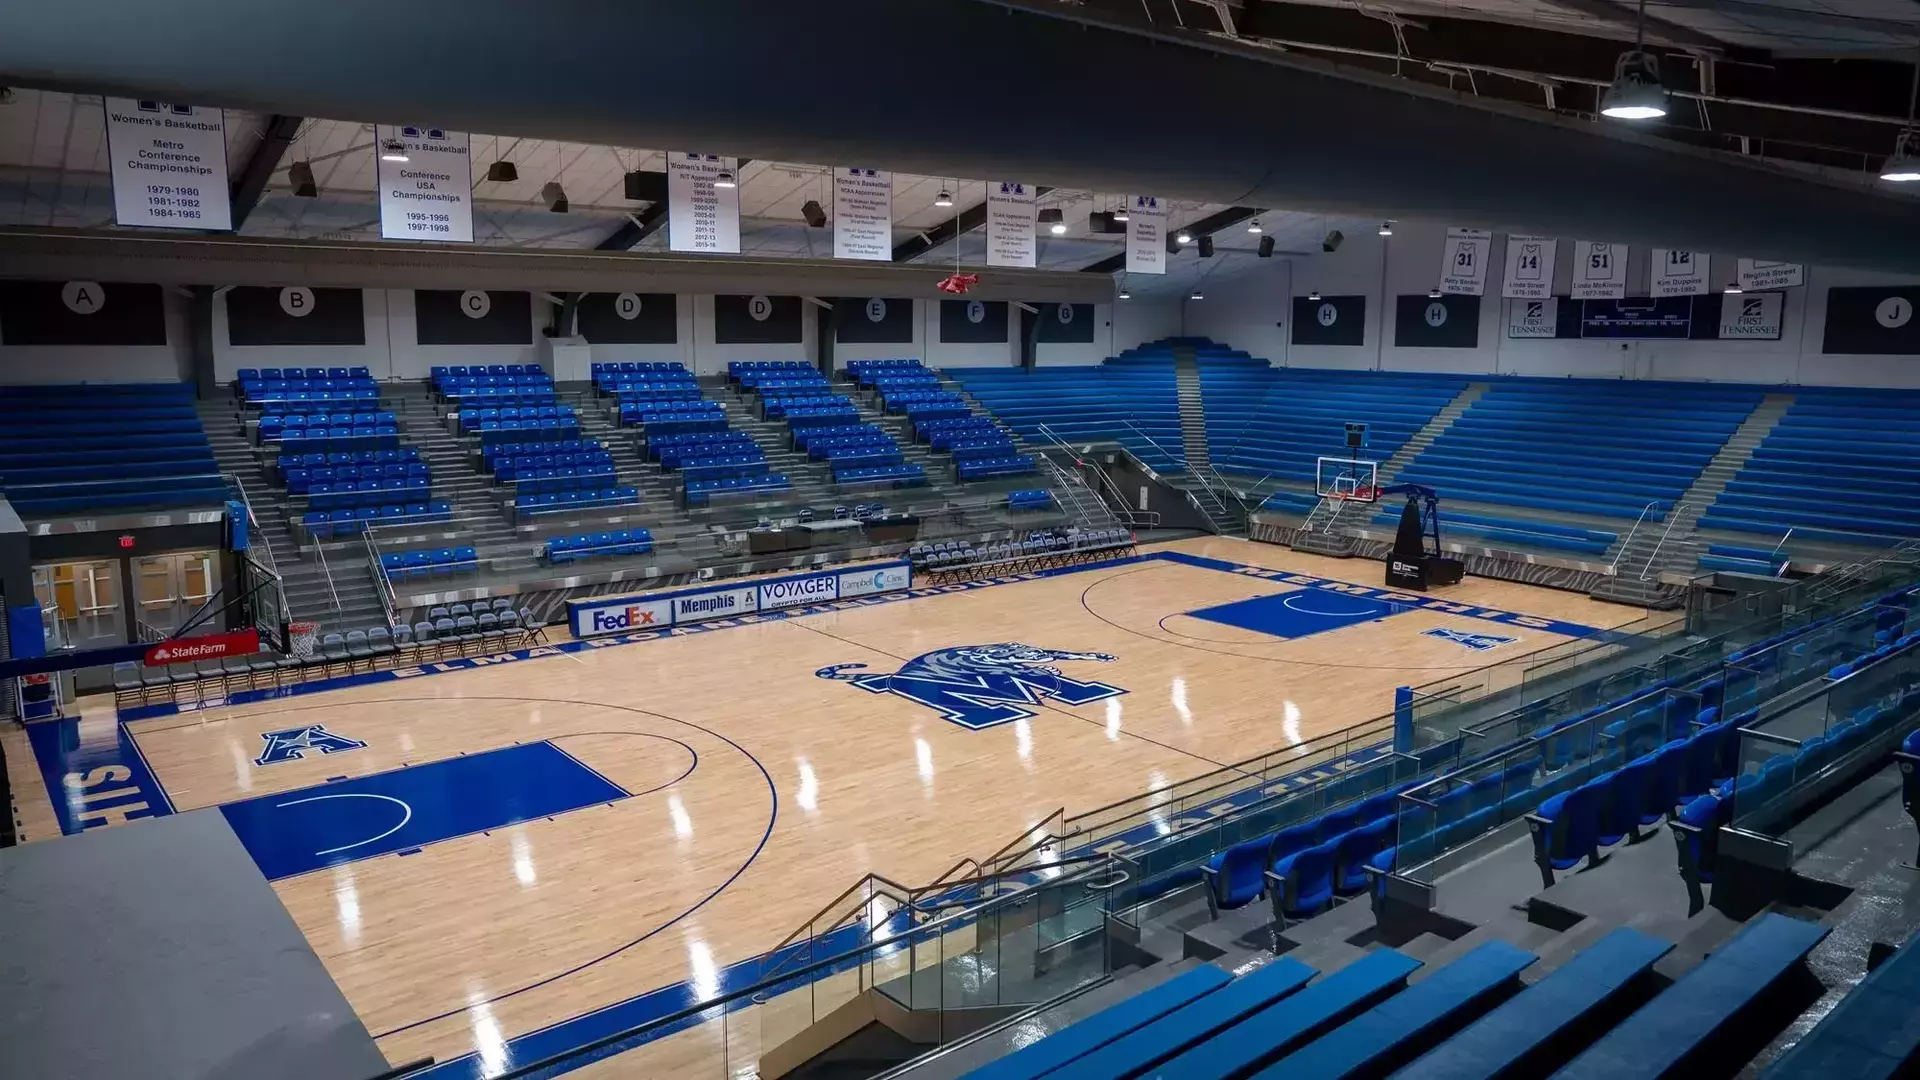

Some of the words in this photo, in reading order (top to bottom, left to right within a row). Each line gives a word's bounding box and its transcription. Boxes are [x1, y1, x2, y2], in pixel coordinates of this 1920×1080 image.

[111, 112, 161, 127] Women's
[164, 119, 220, 132] Basketball
[152, 139, 184, 150] Metro
[422, 143, 467, 155] Basketball
[138, 149, 201, 162] Conference
[128, 160, 213, 176] Championships
[671, 162, 700, 171] Women's
[400, 169, 451, 181] Conference
[146, 185, 199, 196] 1979-1980
[416, 182, 436, 190] USA
[148, 197, 200, 208] 1981-1982
[392, 190, 461, 203] Championships
[149, 208, 201, 219] 1984-1985
[406, 212, 449, 222] 1995-1996
[407, 223, 450, 233] 1997-1998
[1458, 253, 1473, 267] 31
[1521, 256, 1538, 270] 14
[1591, 254, 1609, 269] 51
[1670, 250, 1690, 265] 12
[1772, 268, 1797, 276] Street
[74, 287, 94, 305] A
[290, 292, 303, 309] B
[468, 296, 482, 312] C
[621, 298, 635, 313] D
[754, 300, 766, 315] D
[871, 303, 880, 318] E
[971, 304, 981, 318] F
[1322, 308, 1332, 321] H
[1431, 308, 1442, 321] H
[1888, 304, 1900, 320] J
[1738, 316, 1763, 325] FIRST
[1512, 325, 1554, 334] TENNESSEE
[1723, 325, 1777, 334] TENNESSEE
[763, 577, 834, 600] VOYAGER
[841, 577, 873, 590] Campbell
[886, 573, 904, 583] Clinic
[681, 594, 735, 615] Memphis
[1232, 566, 1555, 629] MEMPHIS
[593, 606, 655, 632] FedEx
[391, 645, 566, 678] ELMA
[586, 612, 768, 648] ROANE
